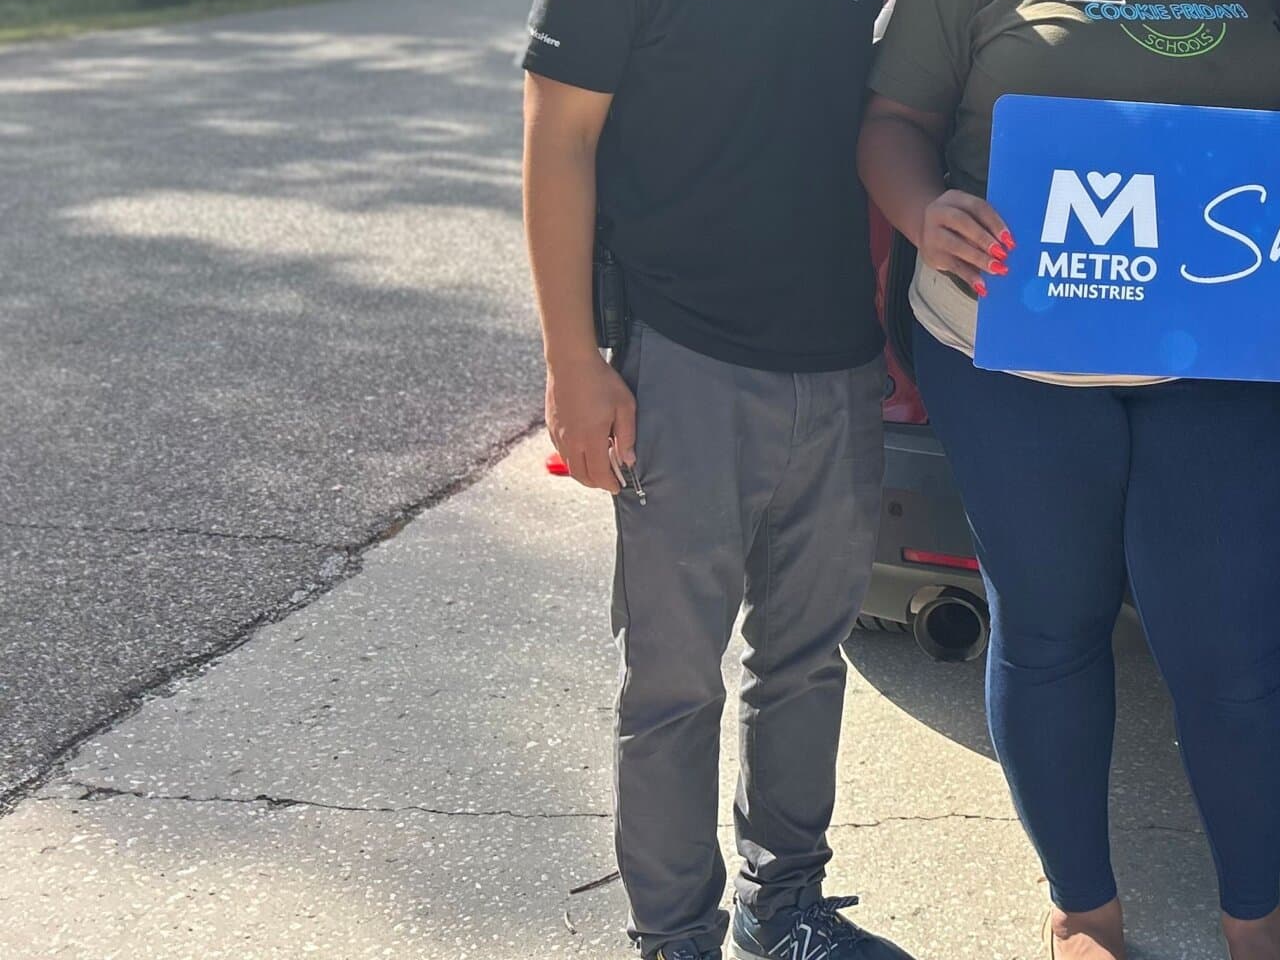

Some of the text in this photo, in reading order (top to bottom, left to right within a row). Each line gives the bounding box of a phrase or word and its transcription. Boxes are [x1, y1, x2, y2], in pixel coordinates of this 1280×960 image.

[1084, 2, 1249, 21] COOKIE FRIDAY!
[1144, 29, 1214, 54] SCHOOLS
[1038, 251, 1158, 282] METRO
[1047, 283, 1145, 301] MINISTRIES
